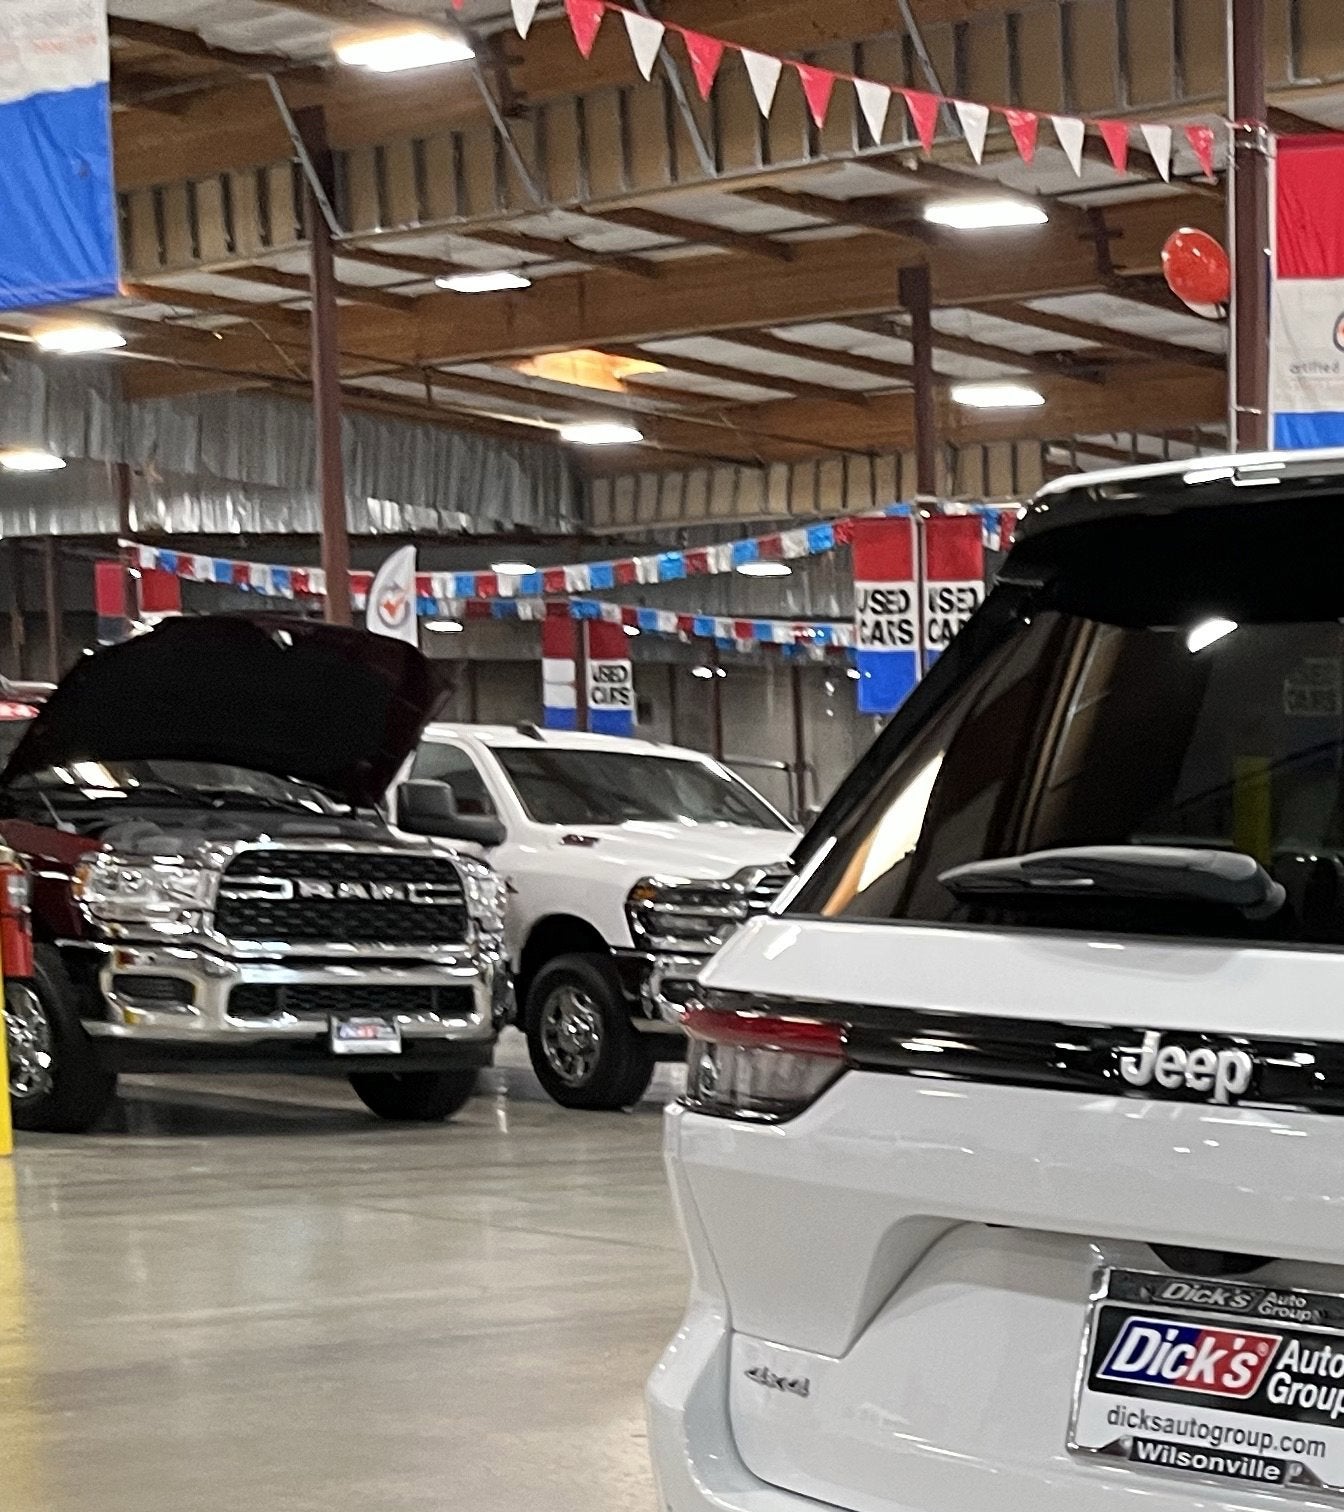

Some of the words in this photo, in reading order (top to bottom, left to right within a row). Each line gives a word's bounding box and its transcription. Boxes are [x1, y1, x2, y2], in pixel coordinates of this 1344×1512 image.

[928, 587, 978, 614] USED
[1119, 1030, 1253, 1105] Jeep
[1161, 1282, 1252, 1308] Dick's
[1263, 1291, 1307, 1308] Auto
[1257, 1301, 1313, 1322] Group
[1111, 1326, 1259, 1389] Dick's
[1106, 1405, 1327, 1458] dicksautogroup.com
[1136, 1440, 1282, 1481] Wilsonville
